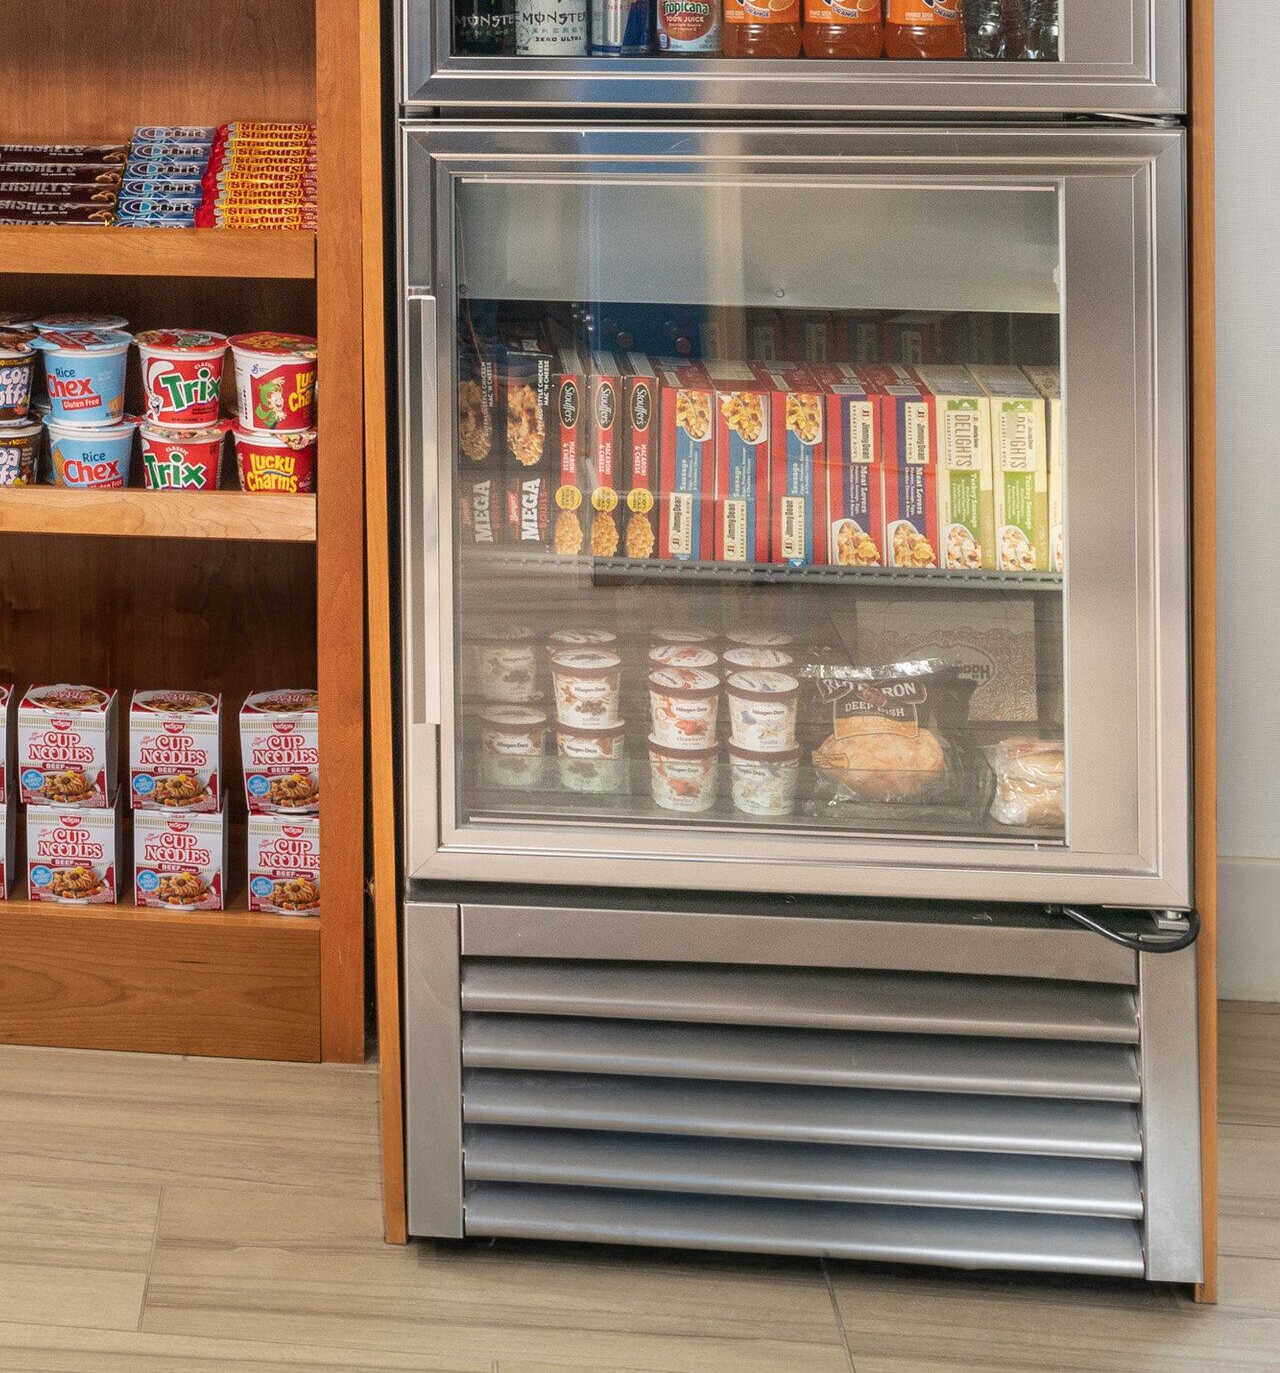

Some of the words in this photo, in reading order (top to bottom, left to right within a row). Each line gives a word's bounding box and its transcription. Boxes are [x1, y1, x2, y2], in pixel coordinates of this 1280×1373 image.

[662, 0, 710, 16] Tropicana
[55, 366, 75, 378] Rice
[47, 374, 95, 398] Chex
[161, 368, 221, 412] Trix
[63, 399, 83, 409] Gluten
[83, 397, 101, 407] Free
[562, 386, 575, 424] Stouffer's
[598, 386, 612, 425] Stouffer's
[633, 387, 647, 425] Stouffer's
[954, 414, 972, 468] DELIGHTS
[82, 451, 106, 462] Rice
[249, 453, 296, 477] Lucky
[62, 459, 121, 484] Chex
[144, 451, 207, 490] Trix
[680, 458, 688, 491] Sausage
[915, 467, 923, 489] Meat
[246, 471, 300, 494] Charms
[472, 480, 493, 543] MEGA
[521, 478, 541, 541] MEGA
[45, 732, 80, 746] CUP
[156, 735, 193, 751] CUP
[268, 735, 304, 750] CUP
[29, 746, 93, 763] NOODLES
[141, 749, 207, 766] NOODLES
[53, 829, 89, 843] CUP
[161, 833, 197, 848] CUP
[275, 839, 312, 853] CUP
[39, 841, 103, 858] NOODLES
[145, 846, 210, 865] NOODLES
